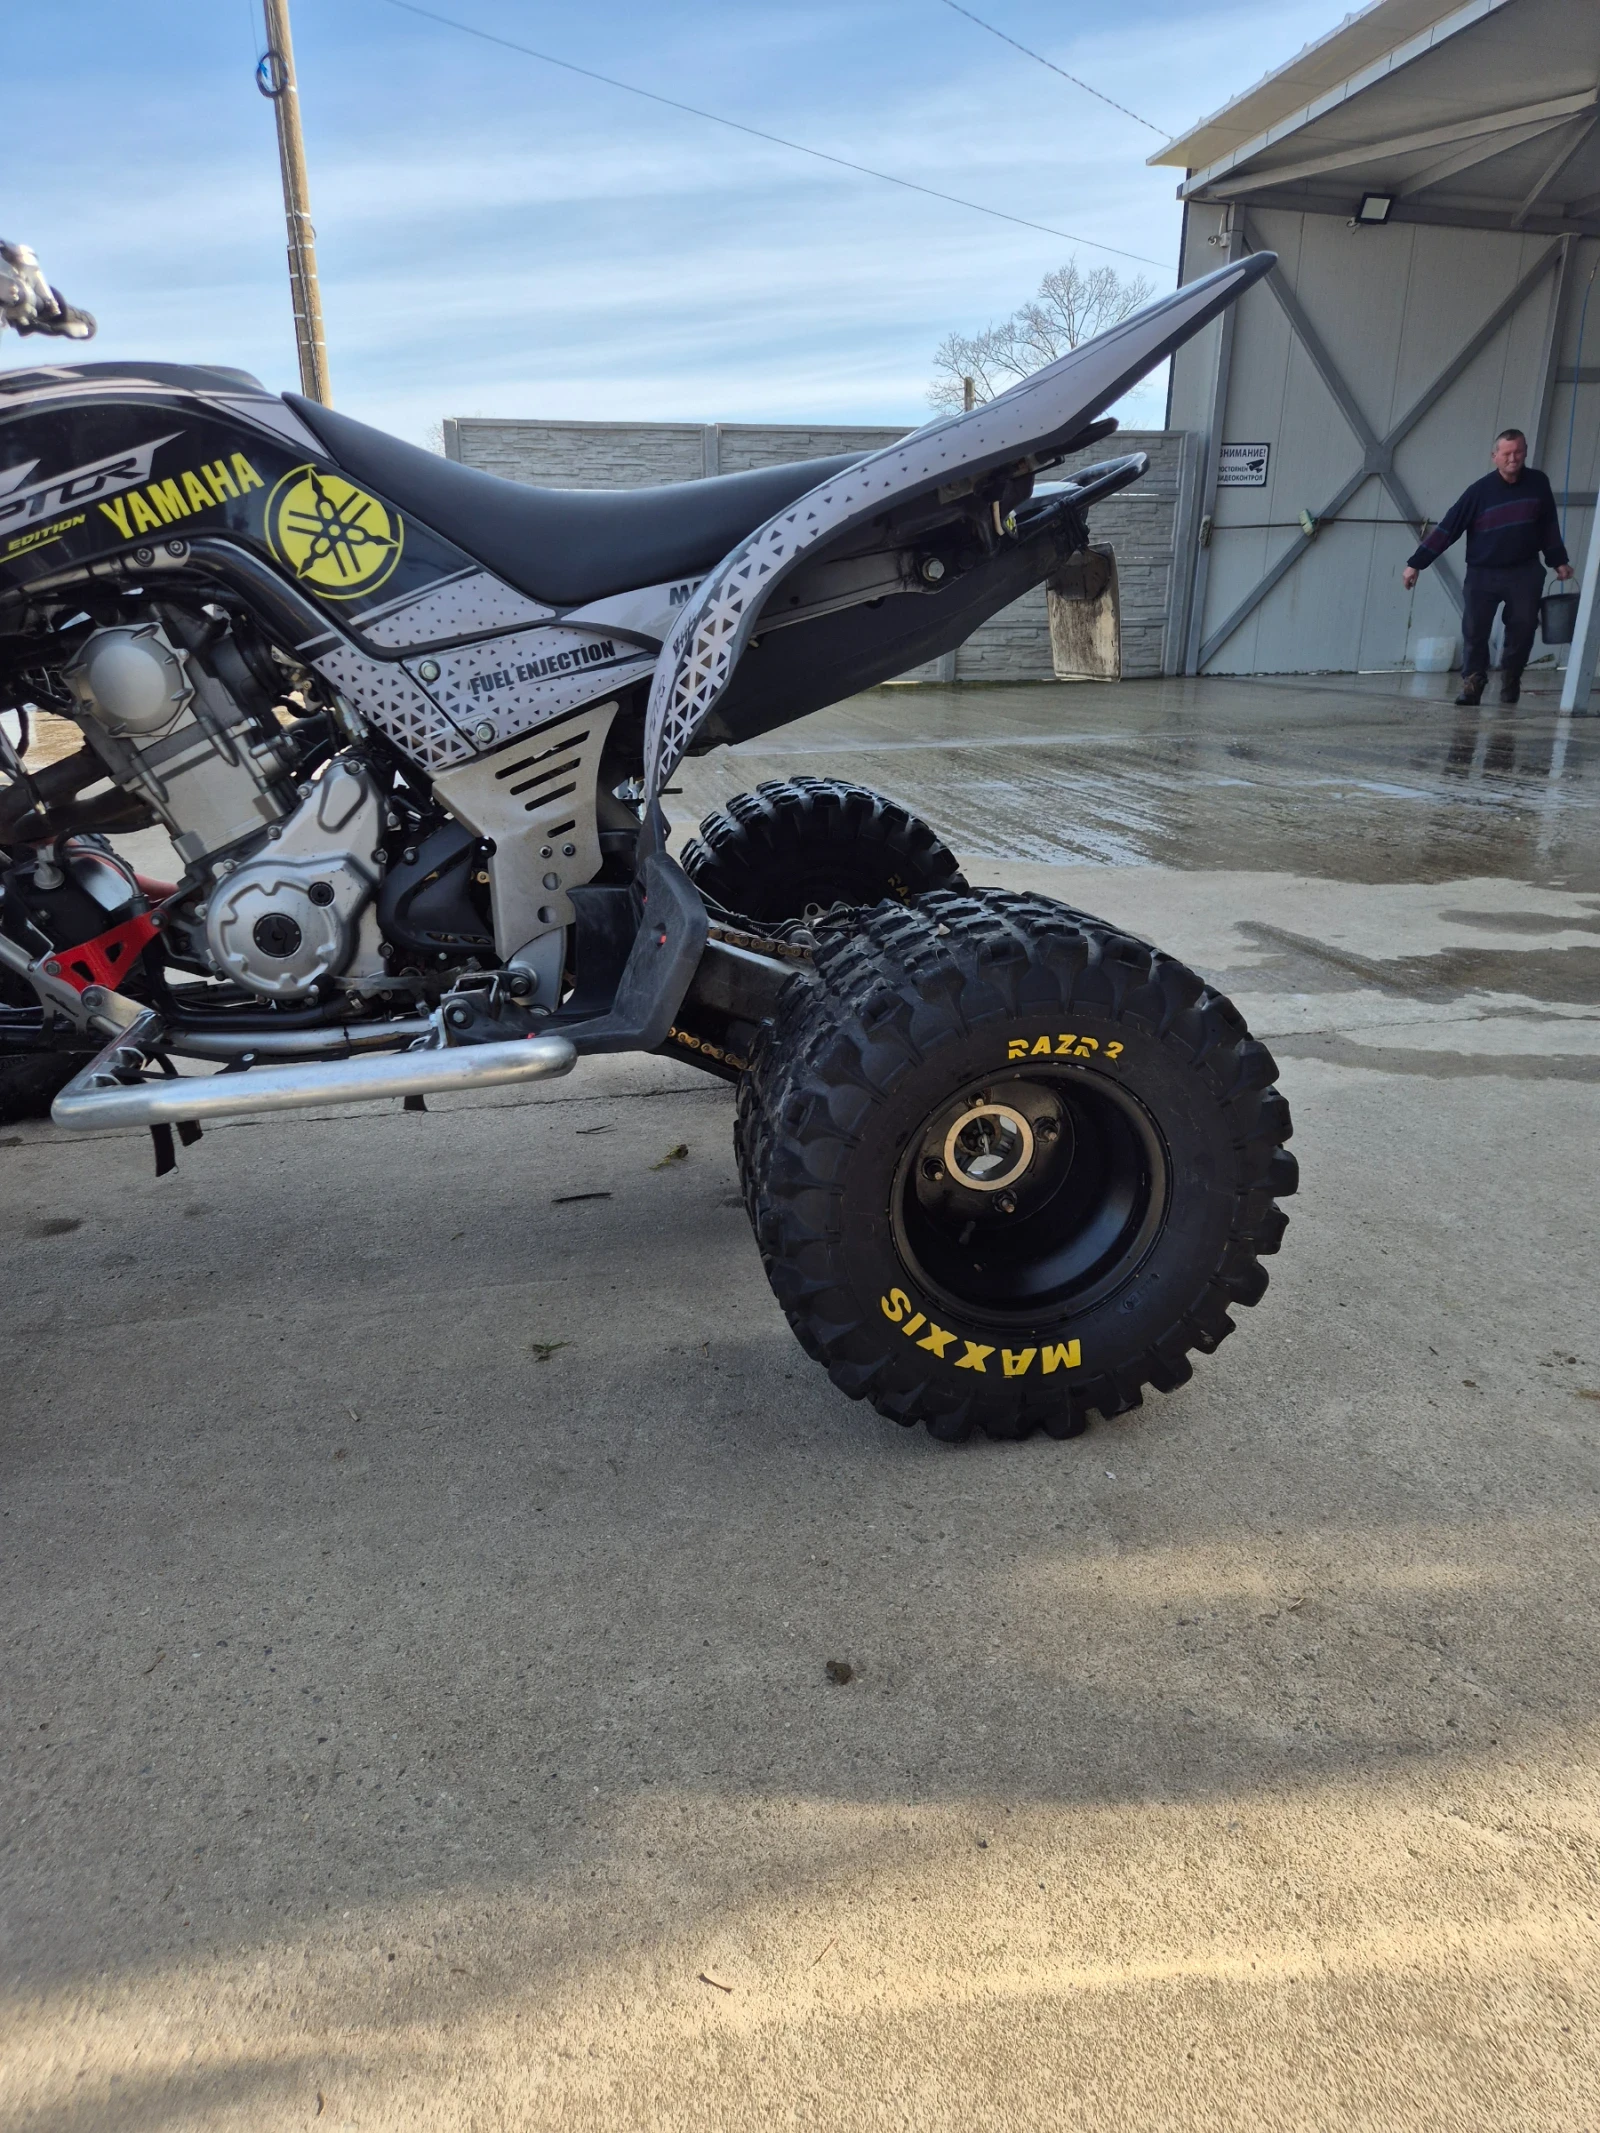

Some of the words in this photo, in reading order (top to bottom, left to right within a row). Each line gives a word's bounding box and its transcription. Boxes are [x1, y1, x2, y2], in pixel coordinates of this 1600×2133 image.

[98, 451, 266, 540] YAMAHA
[8, 513, 87, 552] EDITION
[470, 669, 515, 696] FUEL
[515, 639, 617, 683] ENJECTION
[1008, 1034, 1099, 1060] RAZR
[1102, 1041, 1125, 1059] 2
[881, 1287, 1082, 1377] MAXXIS
